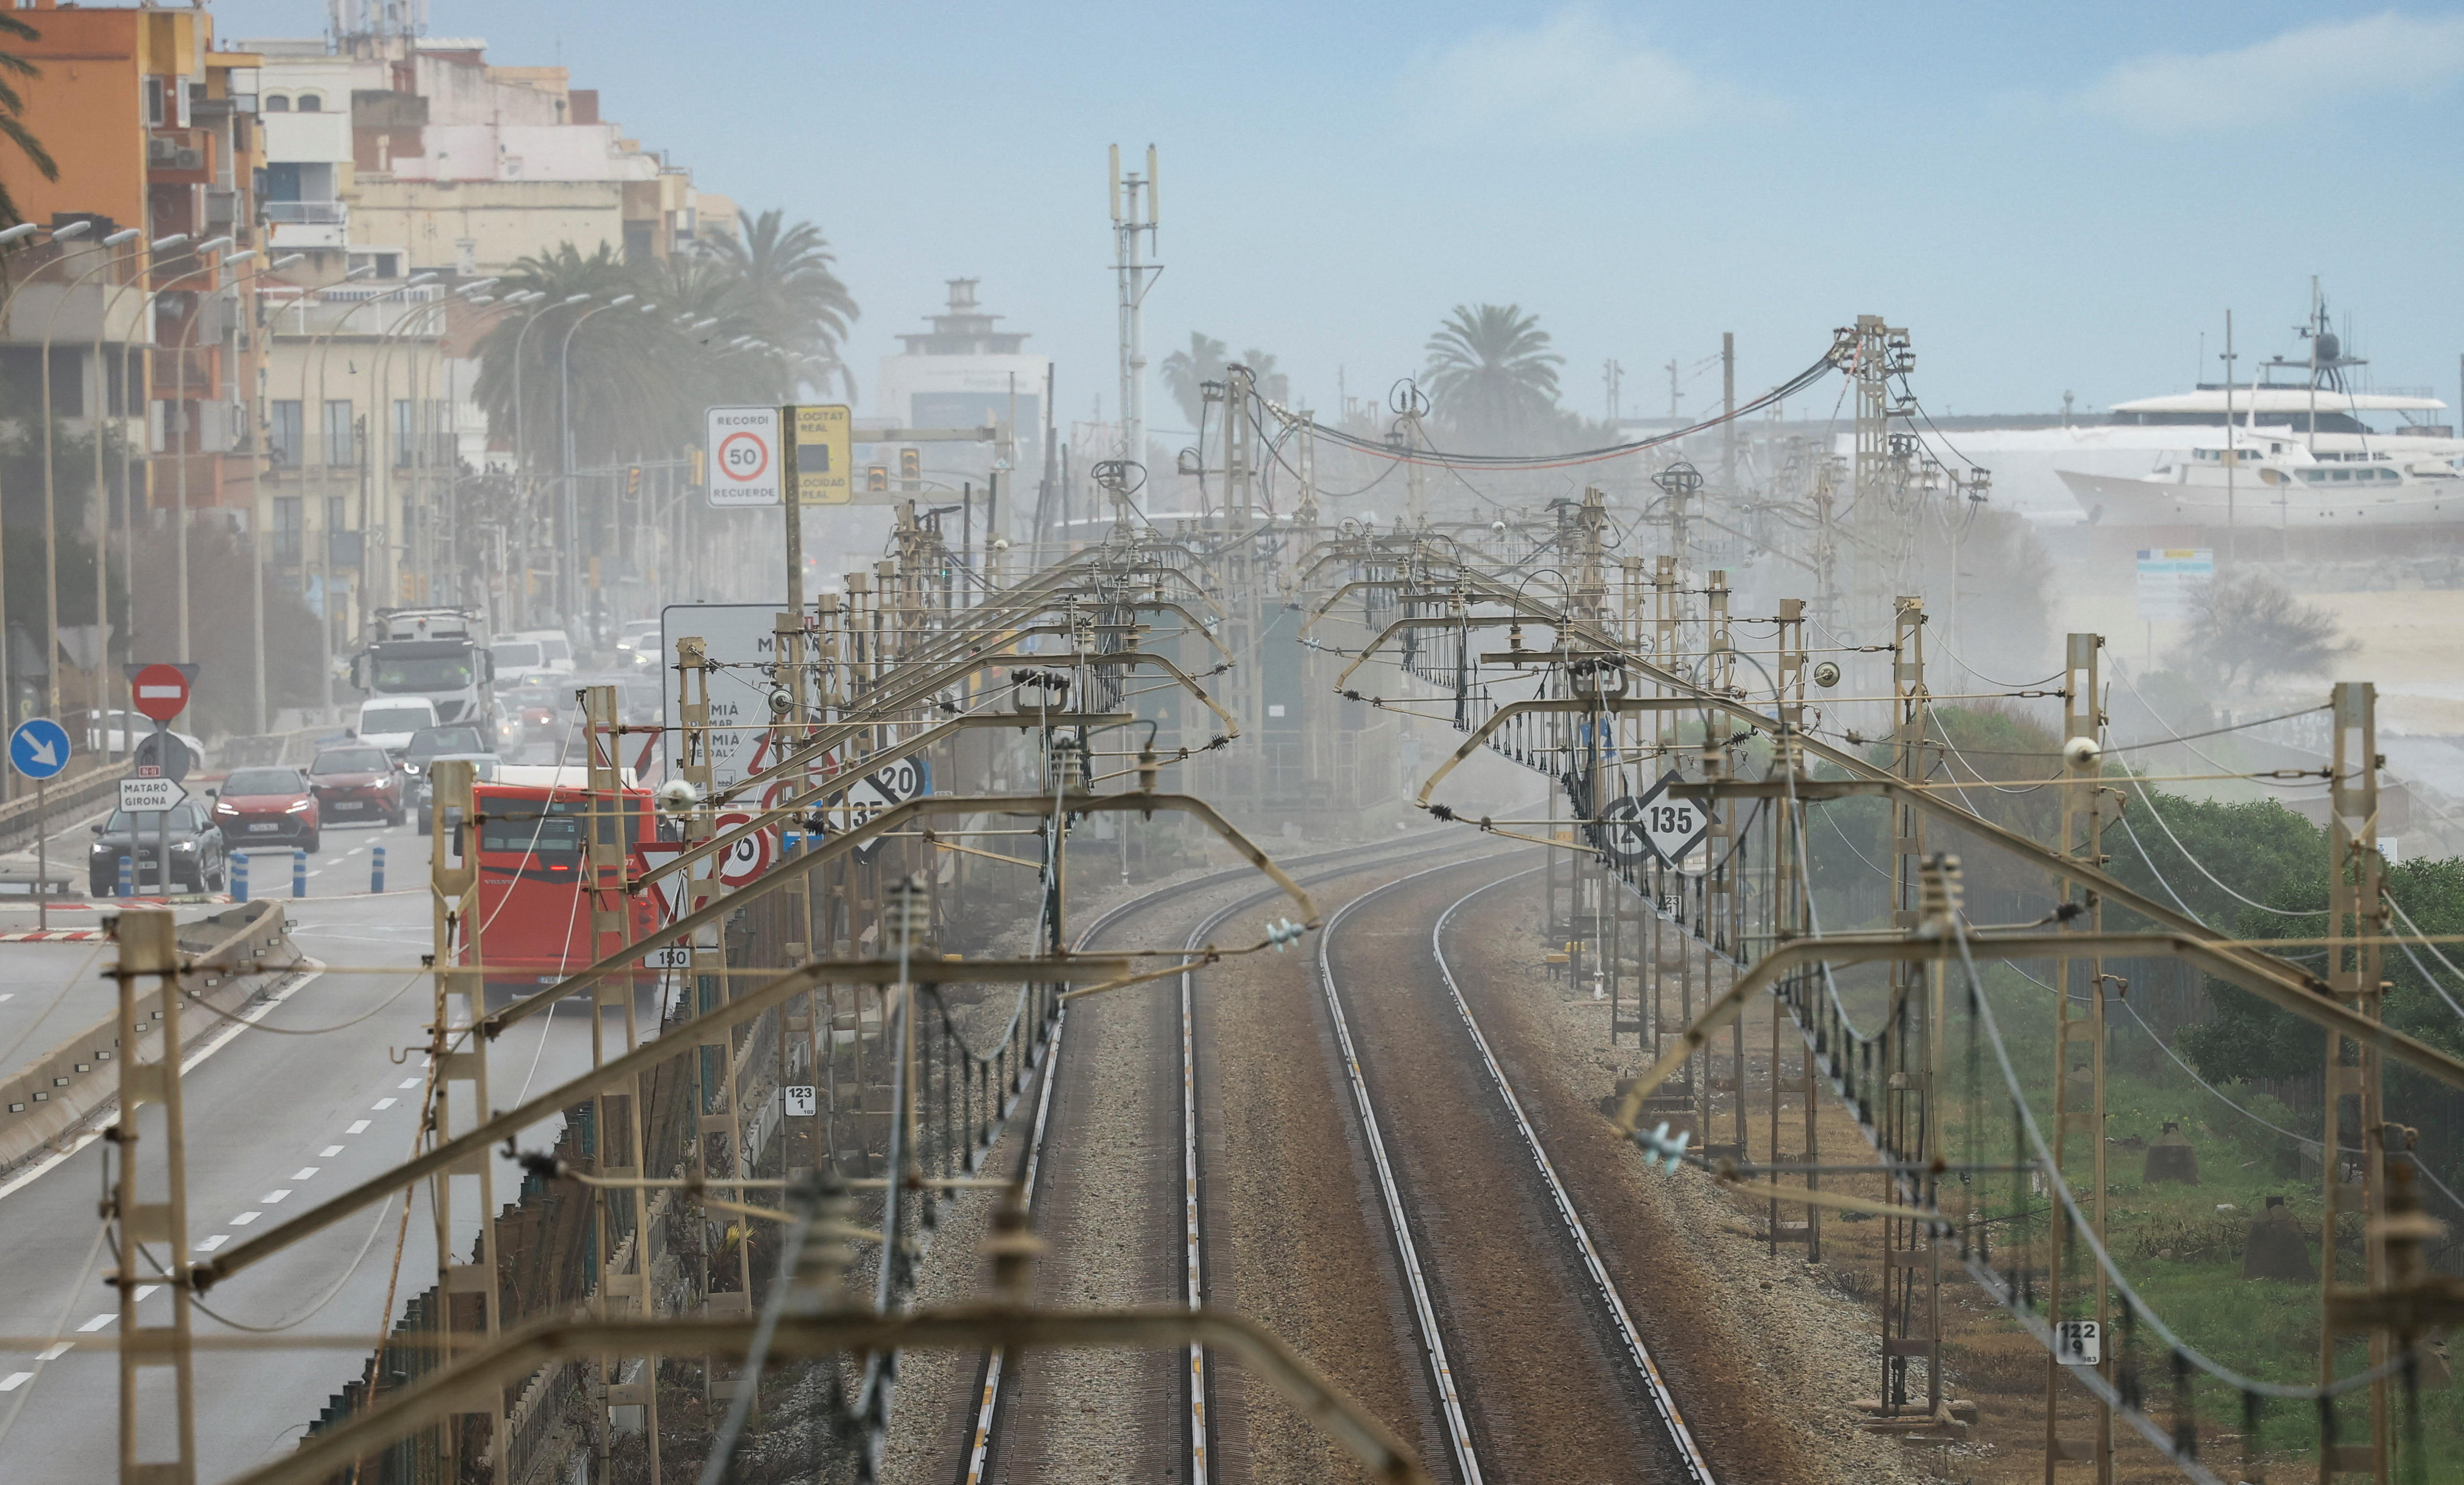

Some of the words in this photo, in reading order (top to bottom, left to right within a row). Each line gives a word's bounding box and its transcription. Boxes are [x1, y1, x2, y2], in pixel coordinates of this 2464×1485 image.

[718, 416, 769, 425] RECORDI
[797, 412, 844, 421] LOCITAT
[730, 449, 756, 465] 50
[714, 488, 775, 497] RECUERDE
[802, 490, 829, 499] REAL
[124, 782, 168, 793] MATARÓ
[125, 797, 167, 806] GIRONA
[1651, 807, 1692, 834] 135
[1666, 897, 1679, 905] 23
[659, 951, 686, 964] 150
[789, 1088, 812, 1098] 123
[798, 1099, 804, 1109] 1
[2061, 1324, 2095, 1338] 122
[2072, 1340, 2083, 1354] 9
